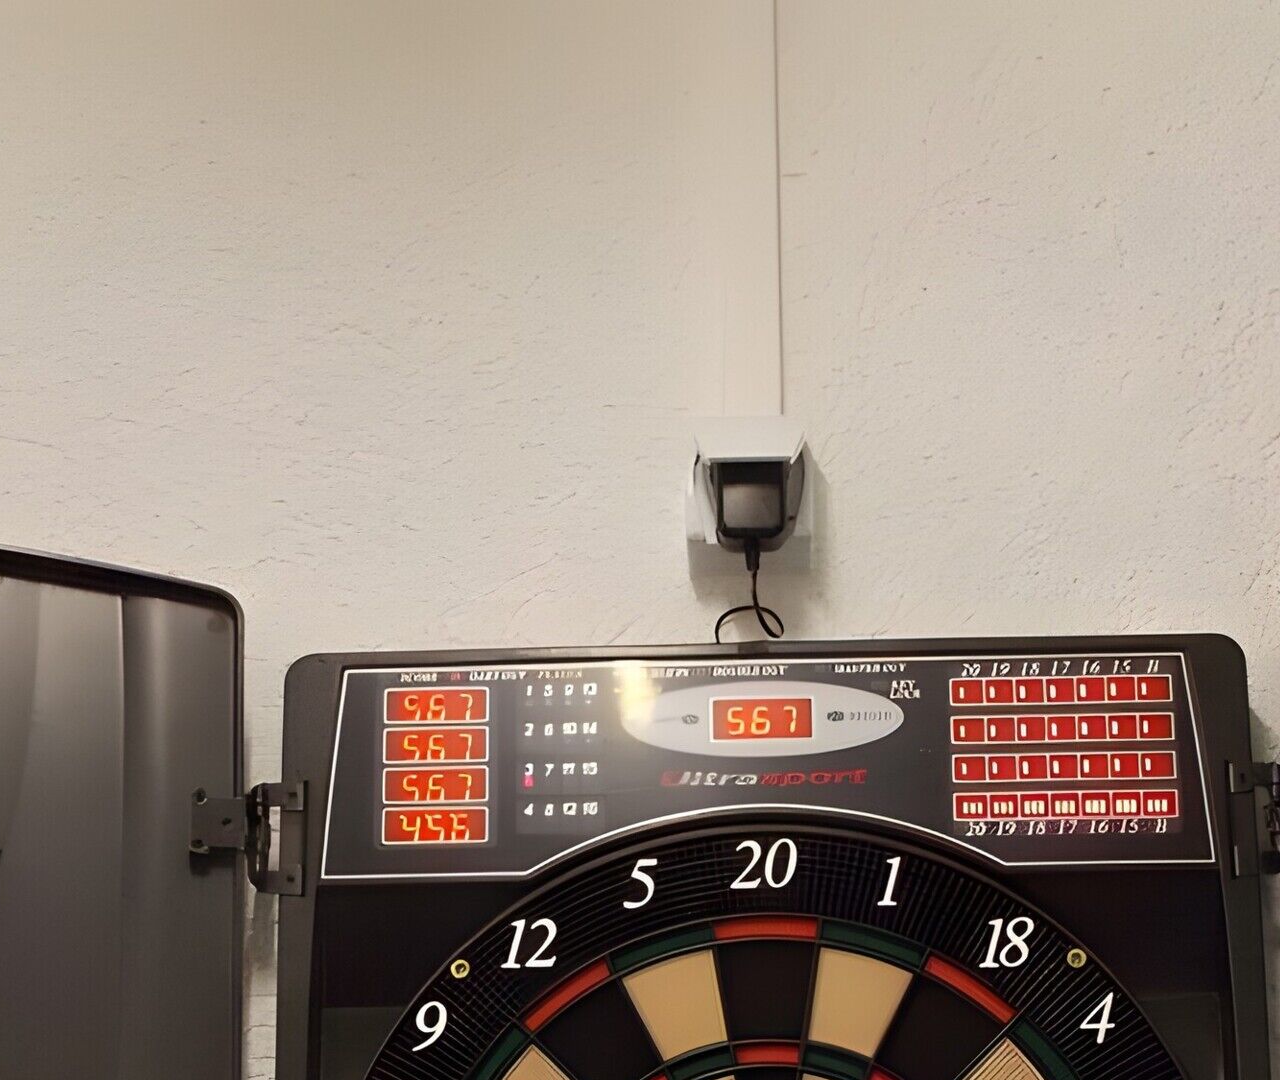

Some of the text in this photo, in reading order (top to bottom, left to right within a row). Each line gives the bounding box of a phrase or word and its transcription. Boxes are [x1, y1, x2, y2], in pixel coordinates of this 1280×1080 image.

[1021, 661, 1041, 677] 18
[1051, 660, 1071, 675] 17
[725, 705, 798, 736] 567
[403, 733, 472, 761] 567
[402, 773, 472, 801] 567
[623, 859, 658, 909] 5
[730, 838, 797, 889] 20
[877, 857, 901, 906] 1
[501, 918, 557, 968] 12
[979, 917, 1034, 968] 18
[412, 1001, 447, 1051] 9
[1080, 992, 1116, 1043] 4
